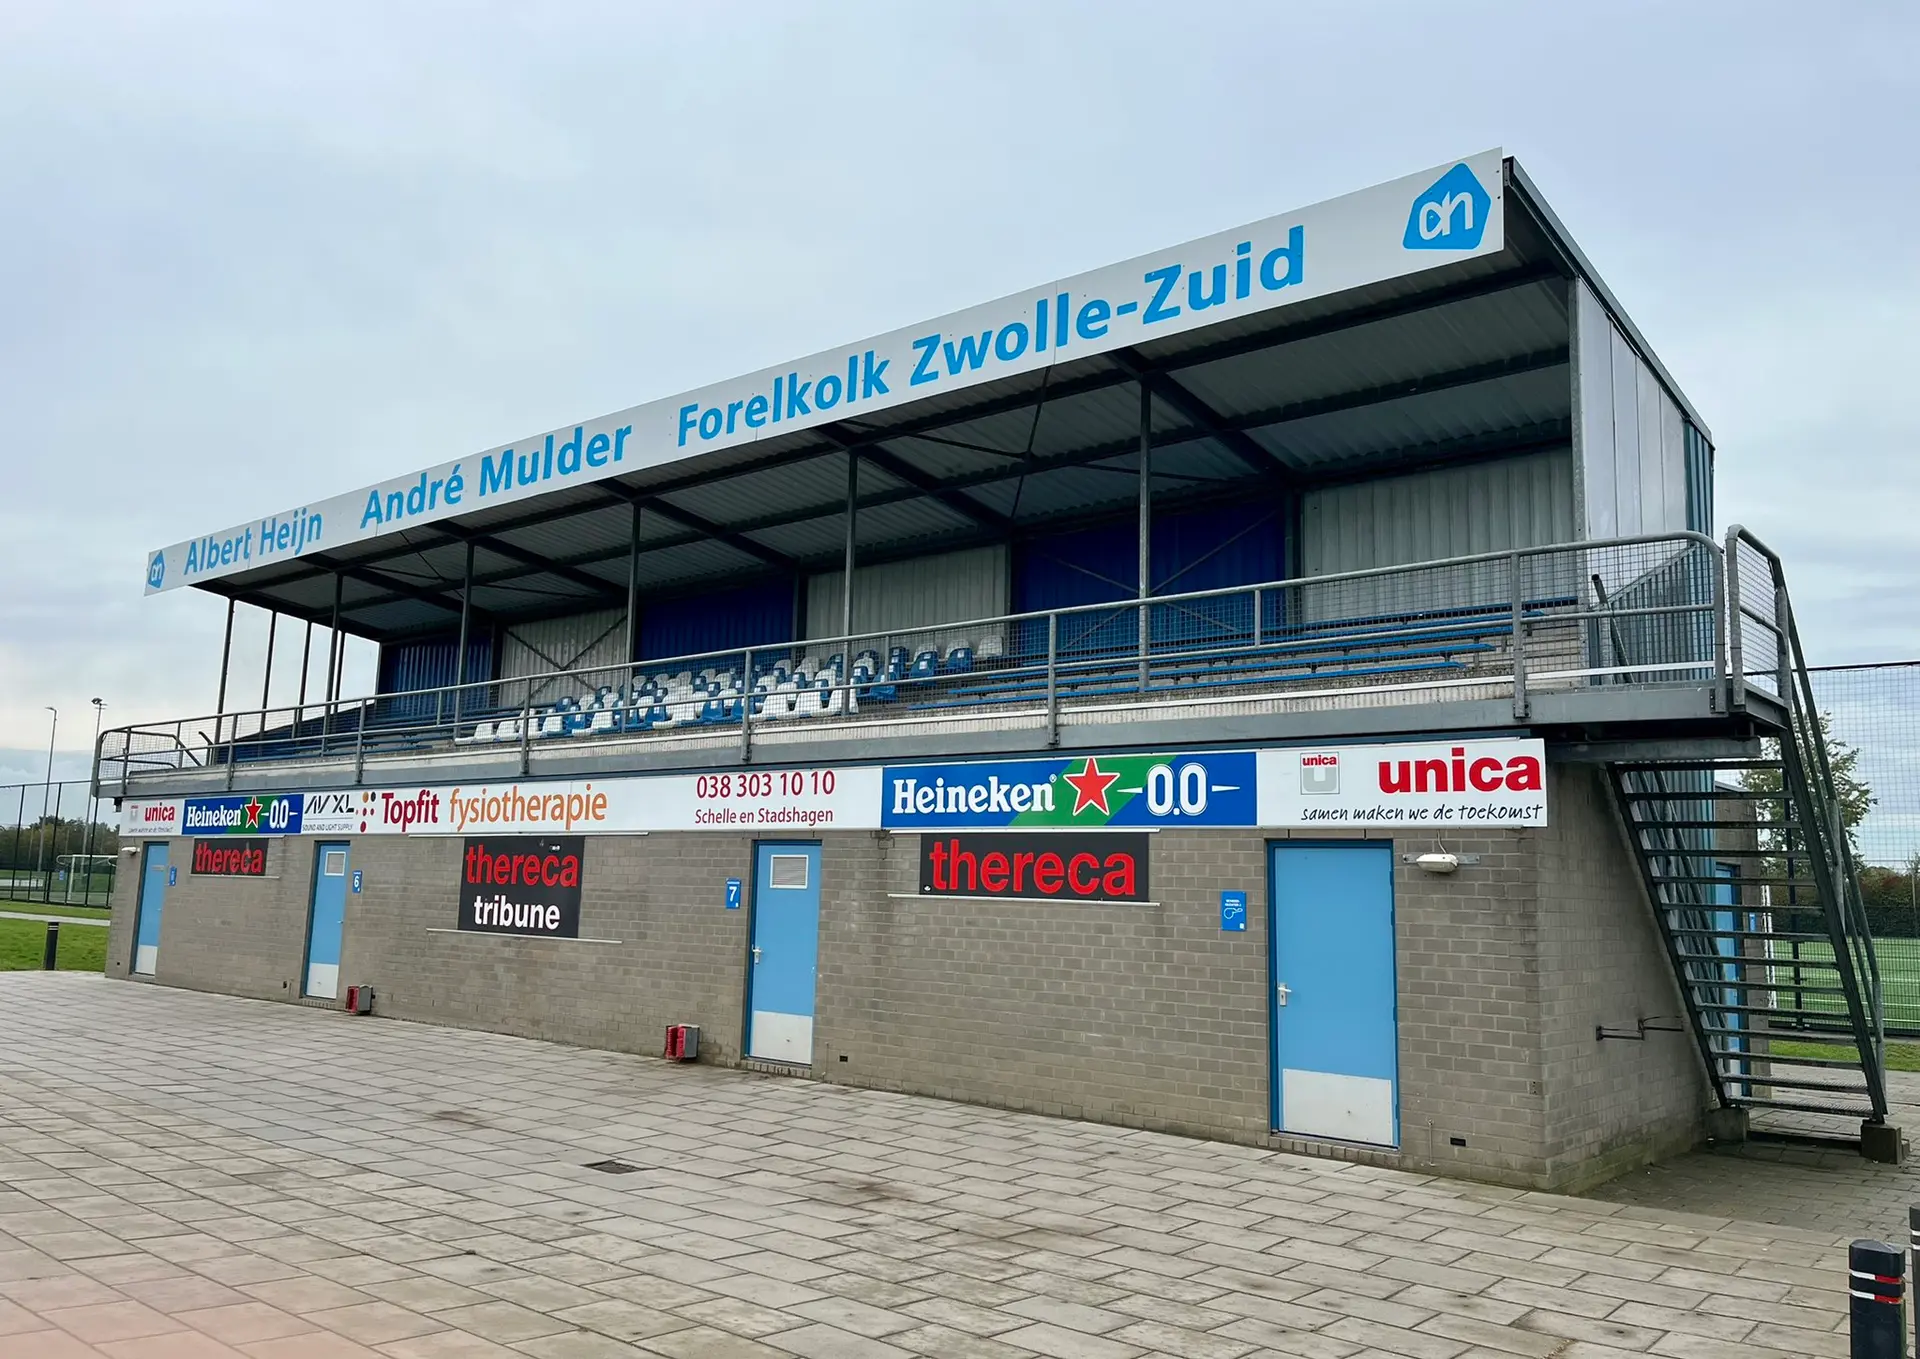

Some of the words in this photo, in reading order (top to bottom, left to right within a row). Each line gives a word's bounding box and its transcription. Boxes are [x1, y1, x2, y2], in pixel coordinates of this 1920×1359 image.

[183, 533, 252, 575] Albert
[259, 508, 322, 555] Heijn
[360, 464, 464, 529] André
[479, 425, 632, 495] Mulder
[676, 350, 891, 448] Forelkolk
[910, 225, 1304, 387] Zwolle-Zuid
[1302, 755, 1337, 766] unica
[1378, 747, 1542, 794] unica
[697, 774, 731, 799] 038
[737, 773, 773, 797] 303
[780, 772, 803, 796] 10
[811, 770, 835, 795] 10
[892, 776, 1055, 814] Heineken
[1146, 763, 1208, 816] 0.0
[144, 802, 175, 821] unica
[186, 804, 241, 827] Heineken
[381, 788, 439, 832] Topfit
[449, 783, 607, 831] fysiotherapie
[695, 807, 737, 824] Schelle
[740, 812, 755, 823] en
[758, 806, 834, 827] Stadshagen
[1301, 808, 1348, 821] samen
[1352, 804, 1404, 821] maken
[1409, 809, 1428, 820] we
[1434, 804, 1454, 820] de
[1458, 803, 1543, 820] toekomst
[338, 823, 353, 831] SUPPLY
[195, 842, 263, 874] thereca
[465, 844, 579, 887] thereca
[930, 839, 1136, 896] thereca
[354, 876, 360, 888] 6
[729, 886, 738, 902] 7
[473, 895, 561, 931] tribune
